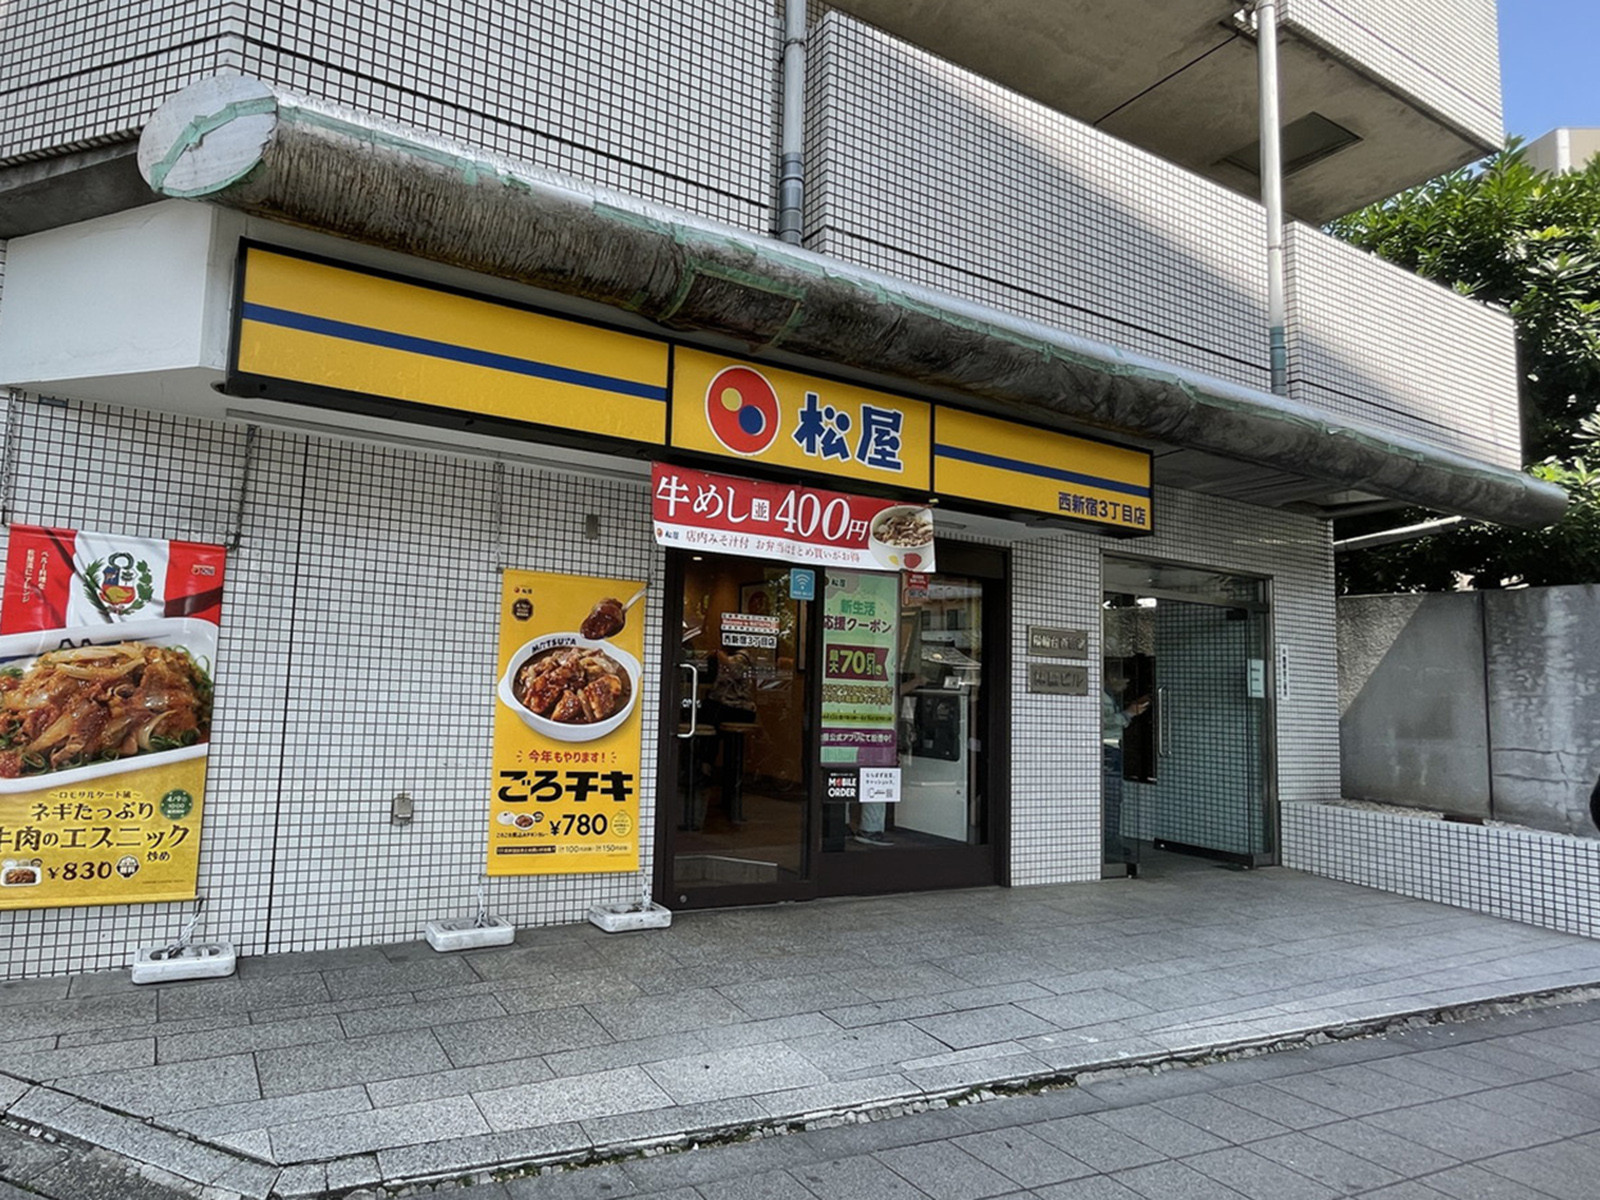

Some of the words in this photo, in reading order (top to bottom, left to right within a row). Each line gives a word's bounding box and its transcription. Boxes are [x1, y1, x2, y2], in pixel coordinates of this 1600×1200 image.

[791, 391, 904, 473] 松屋
[656, 475, 749, 523] 牛めし
[775, 489, 869, 541] 400円
[1058, 491, 1146, 526] 西新宿3丁目店
[686, 529, 749, 549] 店内みそ汁付
[841, 599, 876, 616] 新生活
[824, 615, 892, 633] 応援クーポン
[497, 770, 633, 803] ごろチキ
[828, 787, 857, 798] ORDER
[31, 802, 154, 821] ネギたっぷり
[549, 813, 608, 836] ¥780
[47, 861, 113, 880] ¥830
